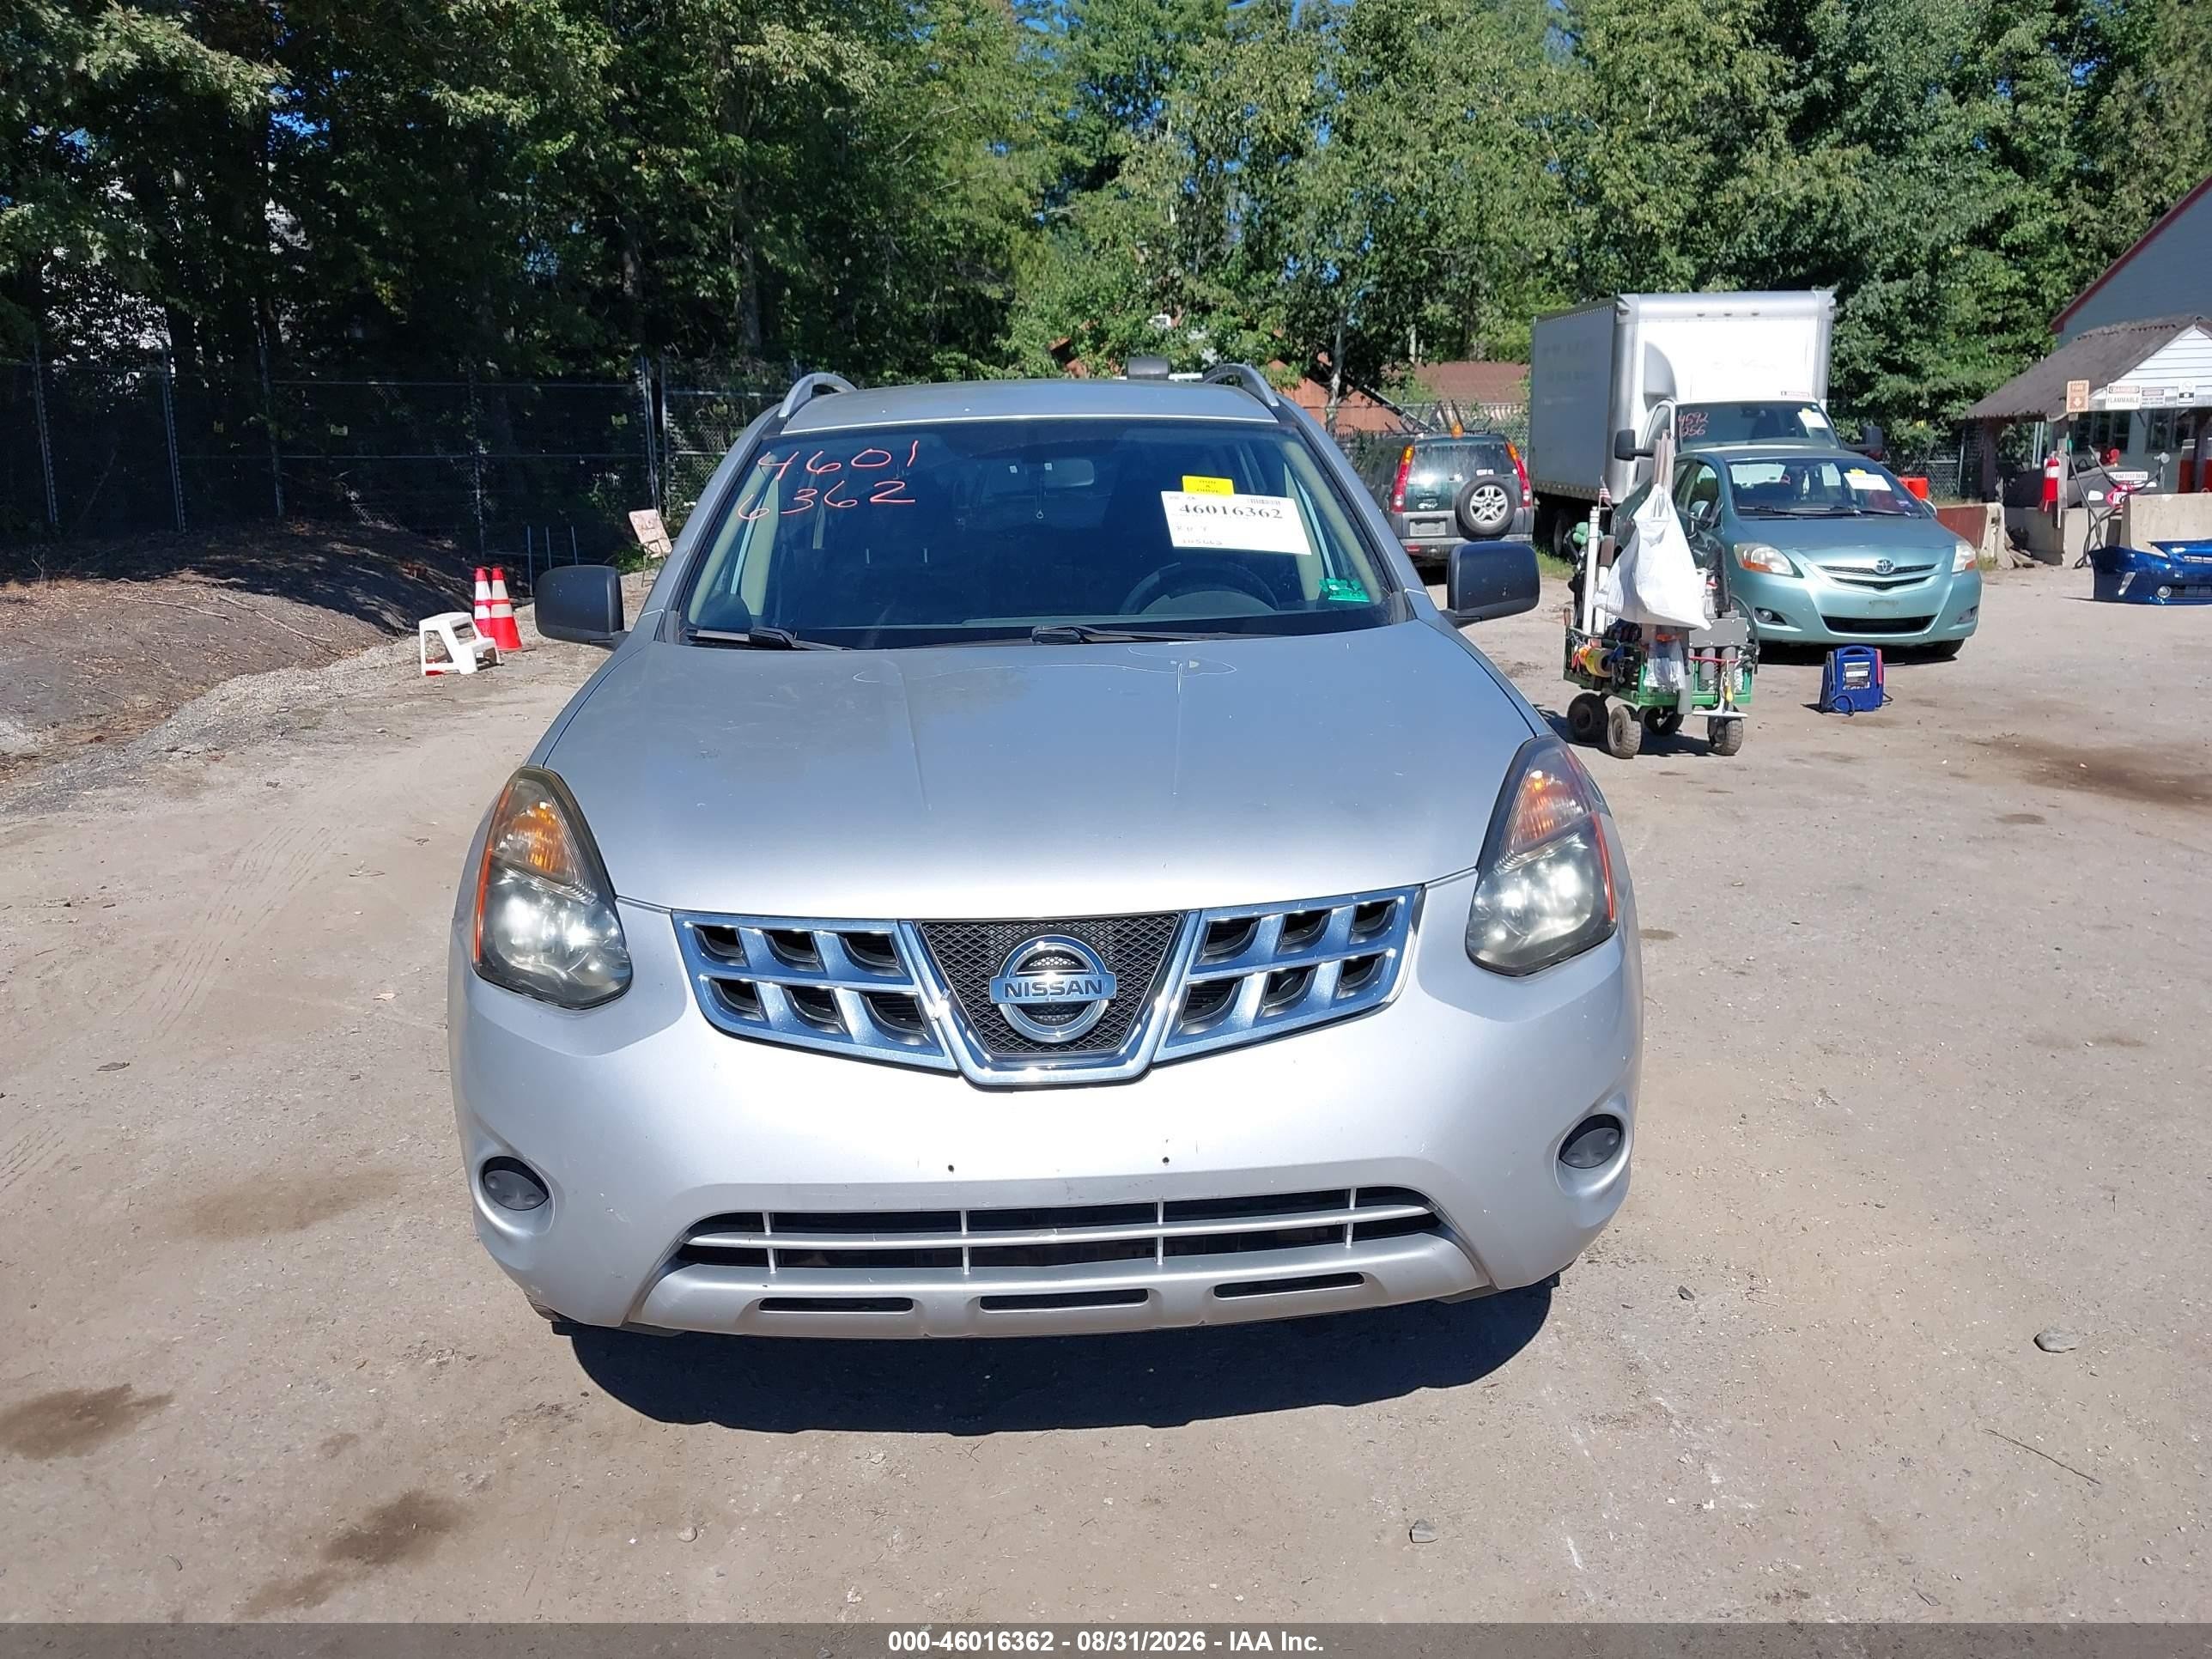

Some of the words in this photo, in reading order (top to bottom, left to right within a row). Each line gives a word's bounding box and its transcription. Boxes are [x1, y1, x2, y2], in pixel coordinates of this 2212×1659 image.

[757, 440, 919, 481] 4601
[738, 480, 916, 520] 6362
[1179, 503, 1283, 520] 46016362
[1004, 980, 1103, 998] NISSAN
